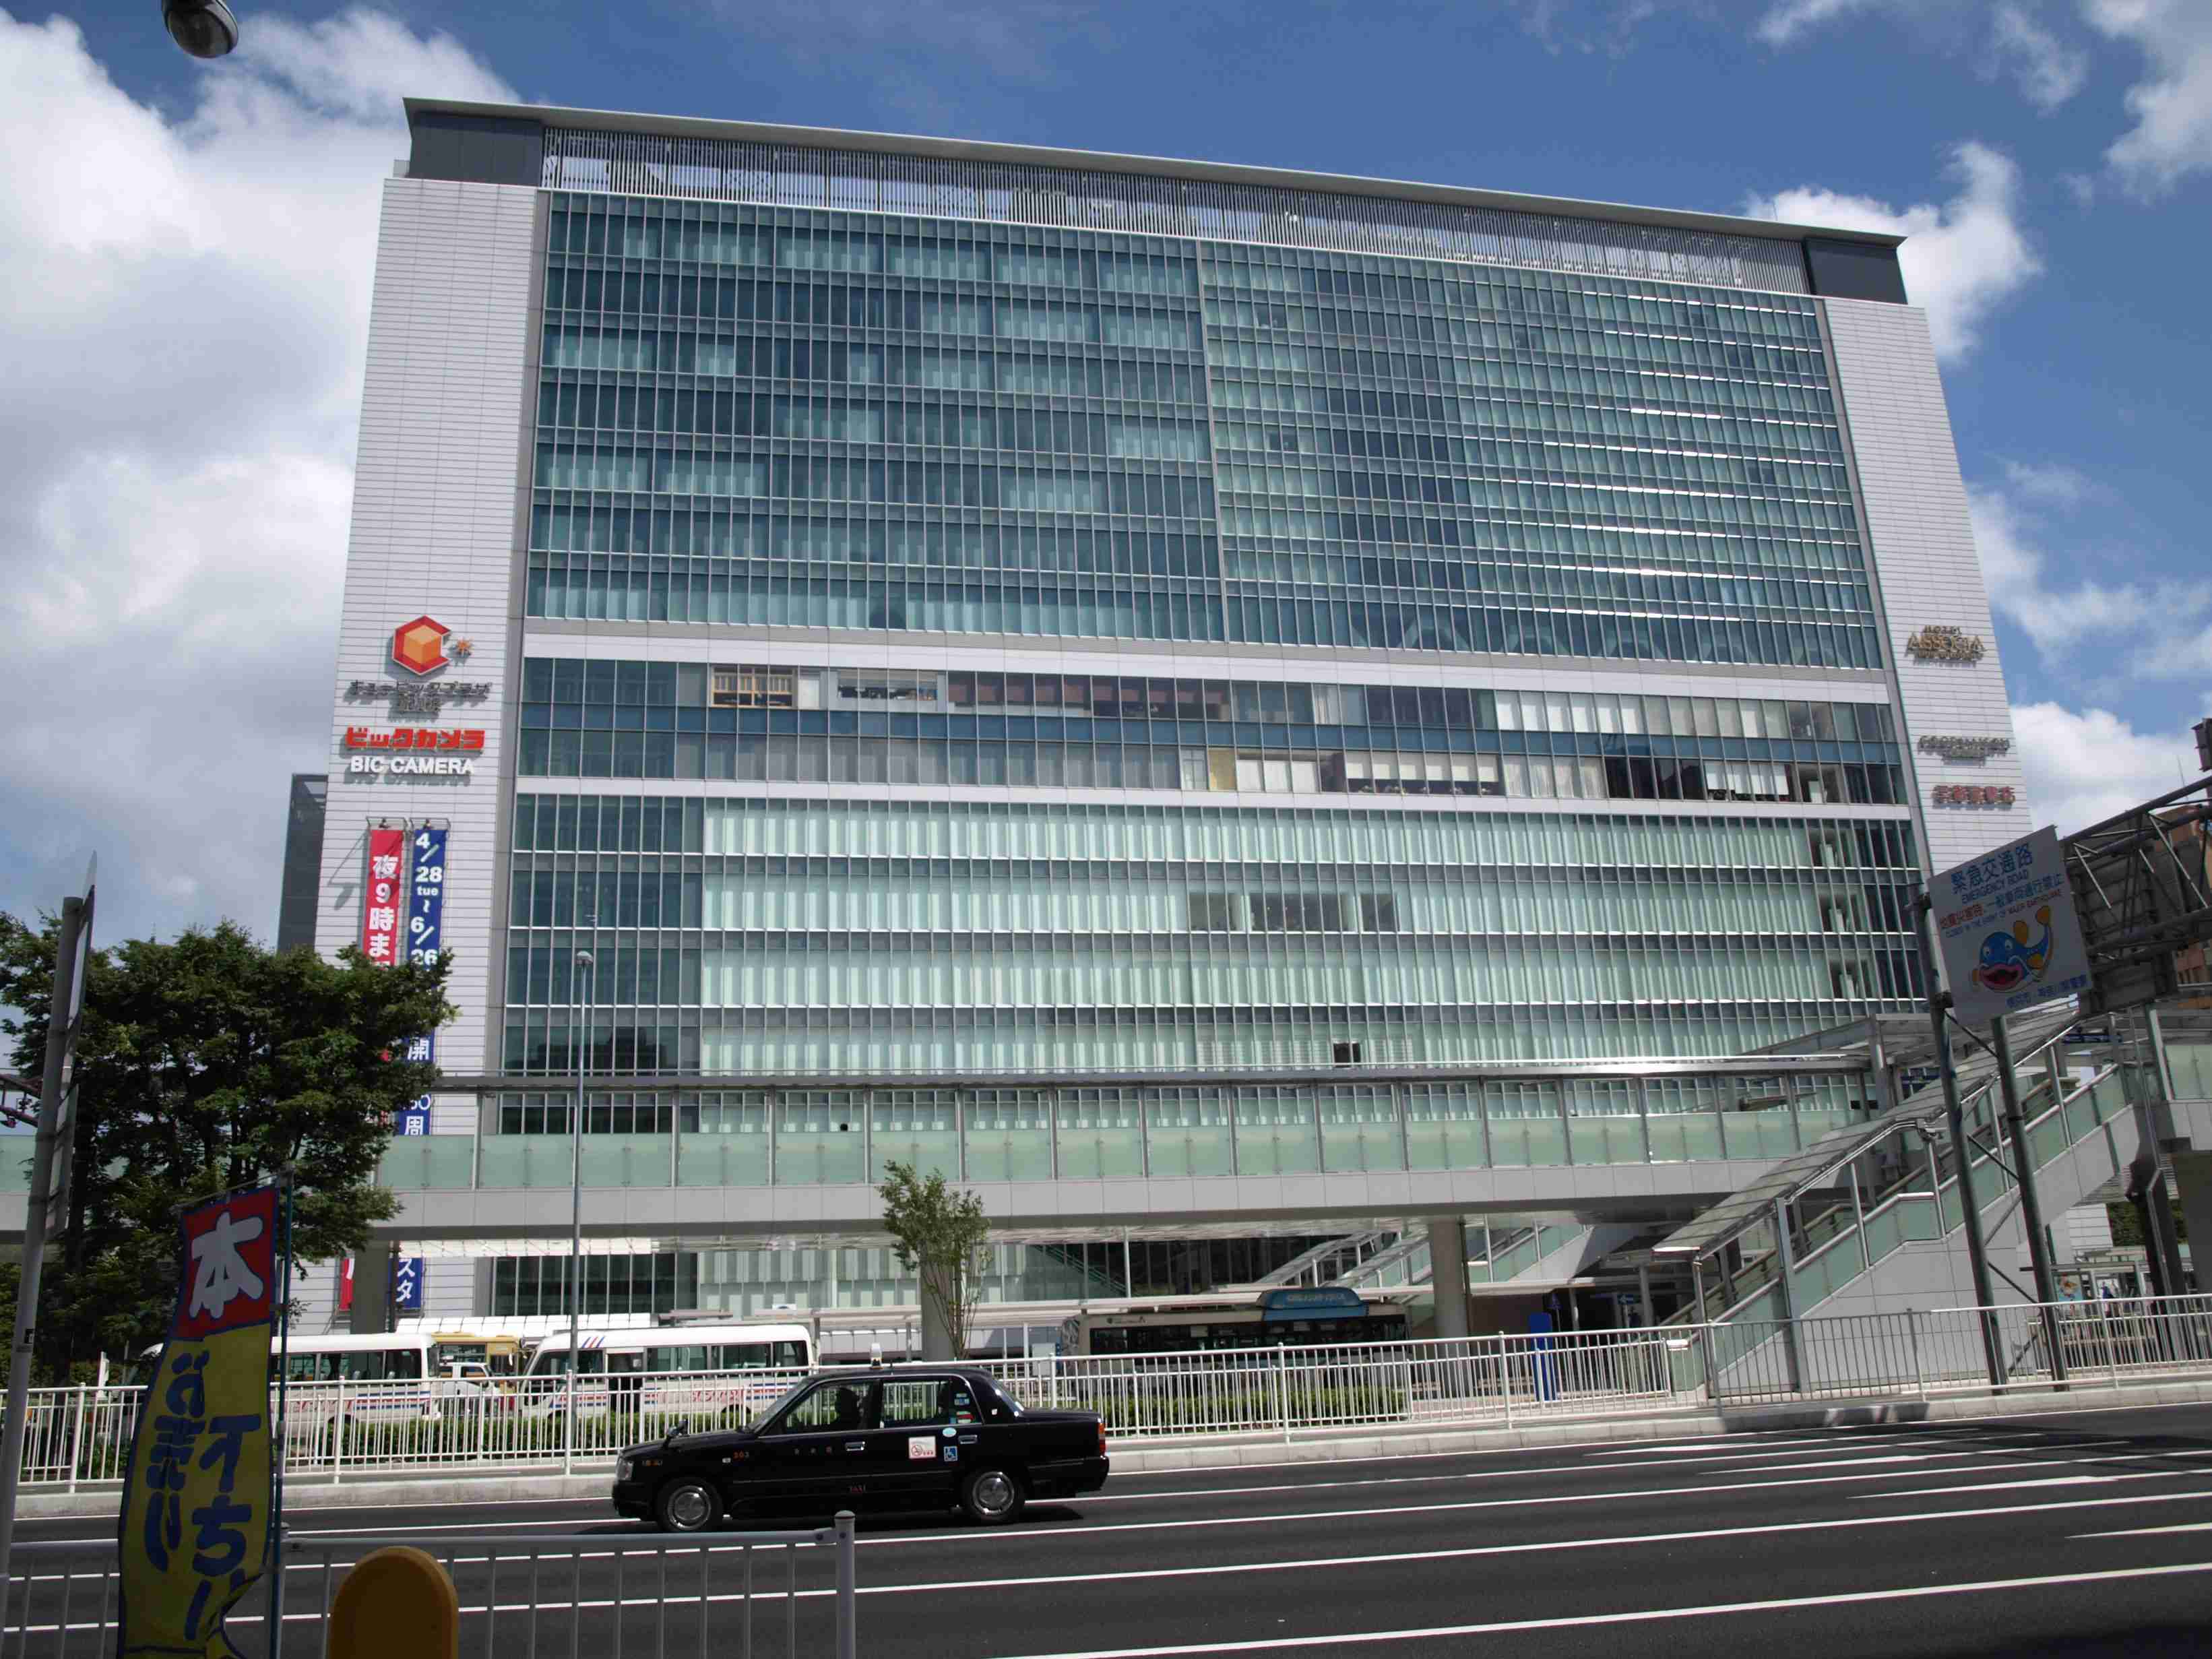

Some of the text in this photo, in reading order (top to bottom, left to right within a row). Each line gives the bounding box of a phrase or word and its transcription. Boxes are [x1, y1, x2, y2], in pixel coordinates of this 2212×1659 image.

[344, 727, 486, 750] ビックカメラ
[350, 755, 475, 774] BIC CAMERA
[1951, 843, 2033, 894] 緊急交通路
[368, 855, 398, 968] 夜9時ま
